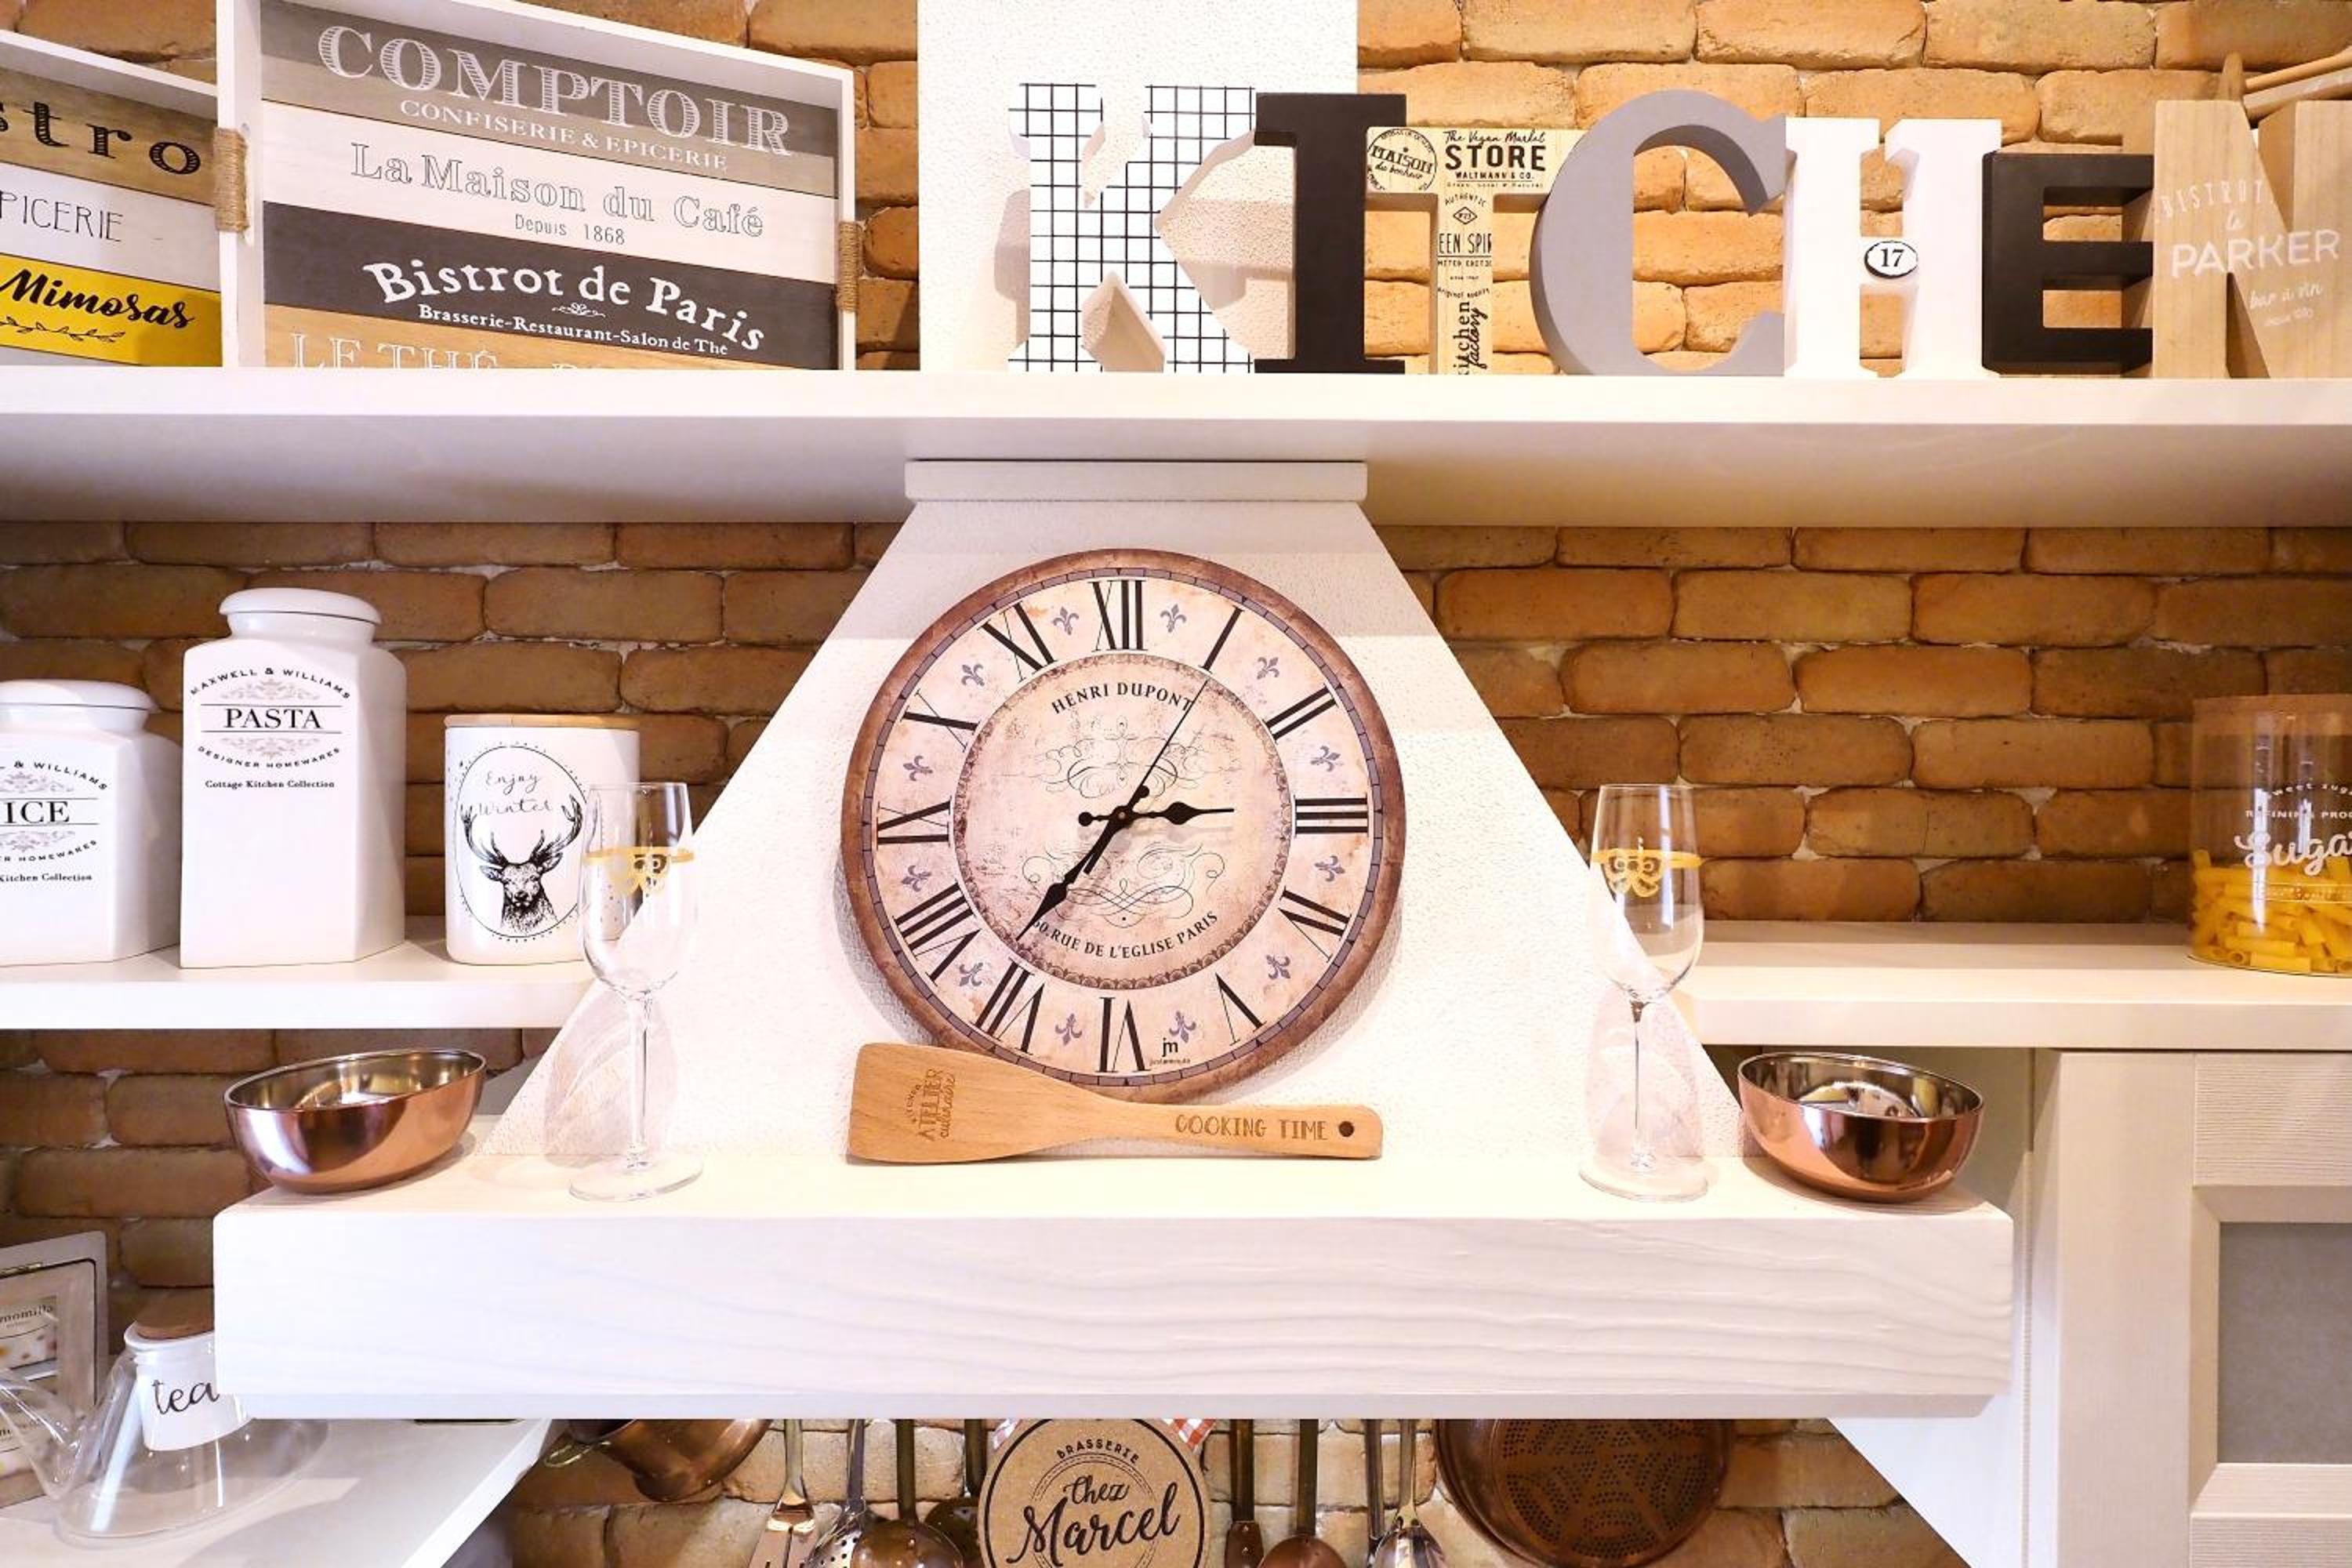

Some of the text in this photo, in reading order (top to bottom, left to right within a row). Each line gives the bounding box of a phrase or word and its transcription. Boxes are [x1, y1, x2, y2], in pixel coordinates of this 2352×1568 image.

[318, 25, 791, 157] COMPTOIR
[400, 99, 728, 172] CONFISERIE & EPICERIE
[1370, 145, 1433, 174] MAISON
[1444, 144, 1547, 172] STORE
[350, 141, 764, 238] La Maison du Café
[514, 212, 625, 247] Depuis 1868
[1439, 233, 1461, 254] EEN
[1880, 248, 1905, 267] 17
[2171, 228, 2341, 278] PARKER
[0, 268, 195, 329] Mimosas
[361, 260, 768, 352] Bistrot de Paris
[290, 332, 362, 368] LE
[672, 336, 690, 352] de
[1458, 307, 1490, 370] factory
[1088, 579, 1147, 652] XII
[981, 601, 1057, 682] XI
[191, 669, 257, 695] MAXWELL
[283, 669, 350, 699] WILLIAMS
[1051, 682, 1194, 714] HENRI DUPONT
[223, 708, 323, 729] PASTA
[902, 690, 979, 753] X
[1264, 683, 1338, 741] II
[14, 760, 107, 790] & WILLIAMS
[198, 745, 339, 769] DESIGNER HOMEWARES
[205, 779, 335, 789] Cottage Kitchen Collection
[485, 771, 542, 795] Enjoy
[4, 800, 71, 824] ICE
[473, 798, 554, 815] Winter
[1294, 797, 1370, 836] III
[19, 840, 97, 862] HOMEWARES
[2234, 831, 2352, 876] Suga
[42, 873, 93, 882] Collection
[894, 882, 981, 985] VIII
[1084, 941, 1104, 958] DE
[1109, 937, 1175, 960] L'EGLISE
[1177, 910, 1218, 945] PARIS
[971, 957, 1045, 1057] VII
[1214, 972, 1267, 1046] V
[1096, 996, 1152, 1073] VI
[1162, 1037, 1178, 1057] jm
[917, 1069, 943, 1142] ATELIER
[1175, 1114, 1328, 1141] COOKING TIME
[151, 1377, 220, 1415] tea
[1056, 1438, 1140, 1465] BRASSERIE
[1006, 1480, 1181, 1568] Marcel
